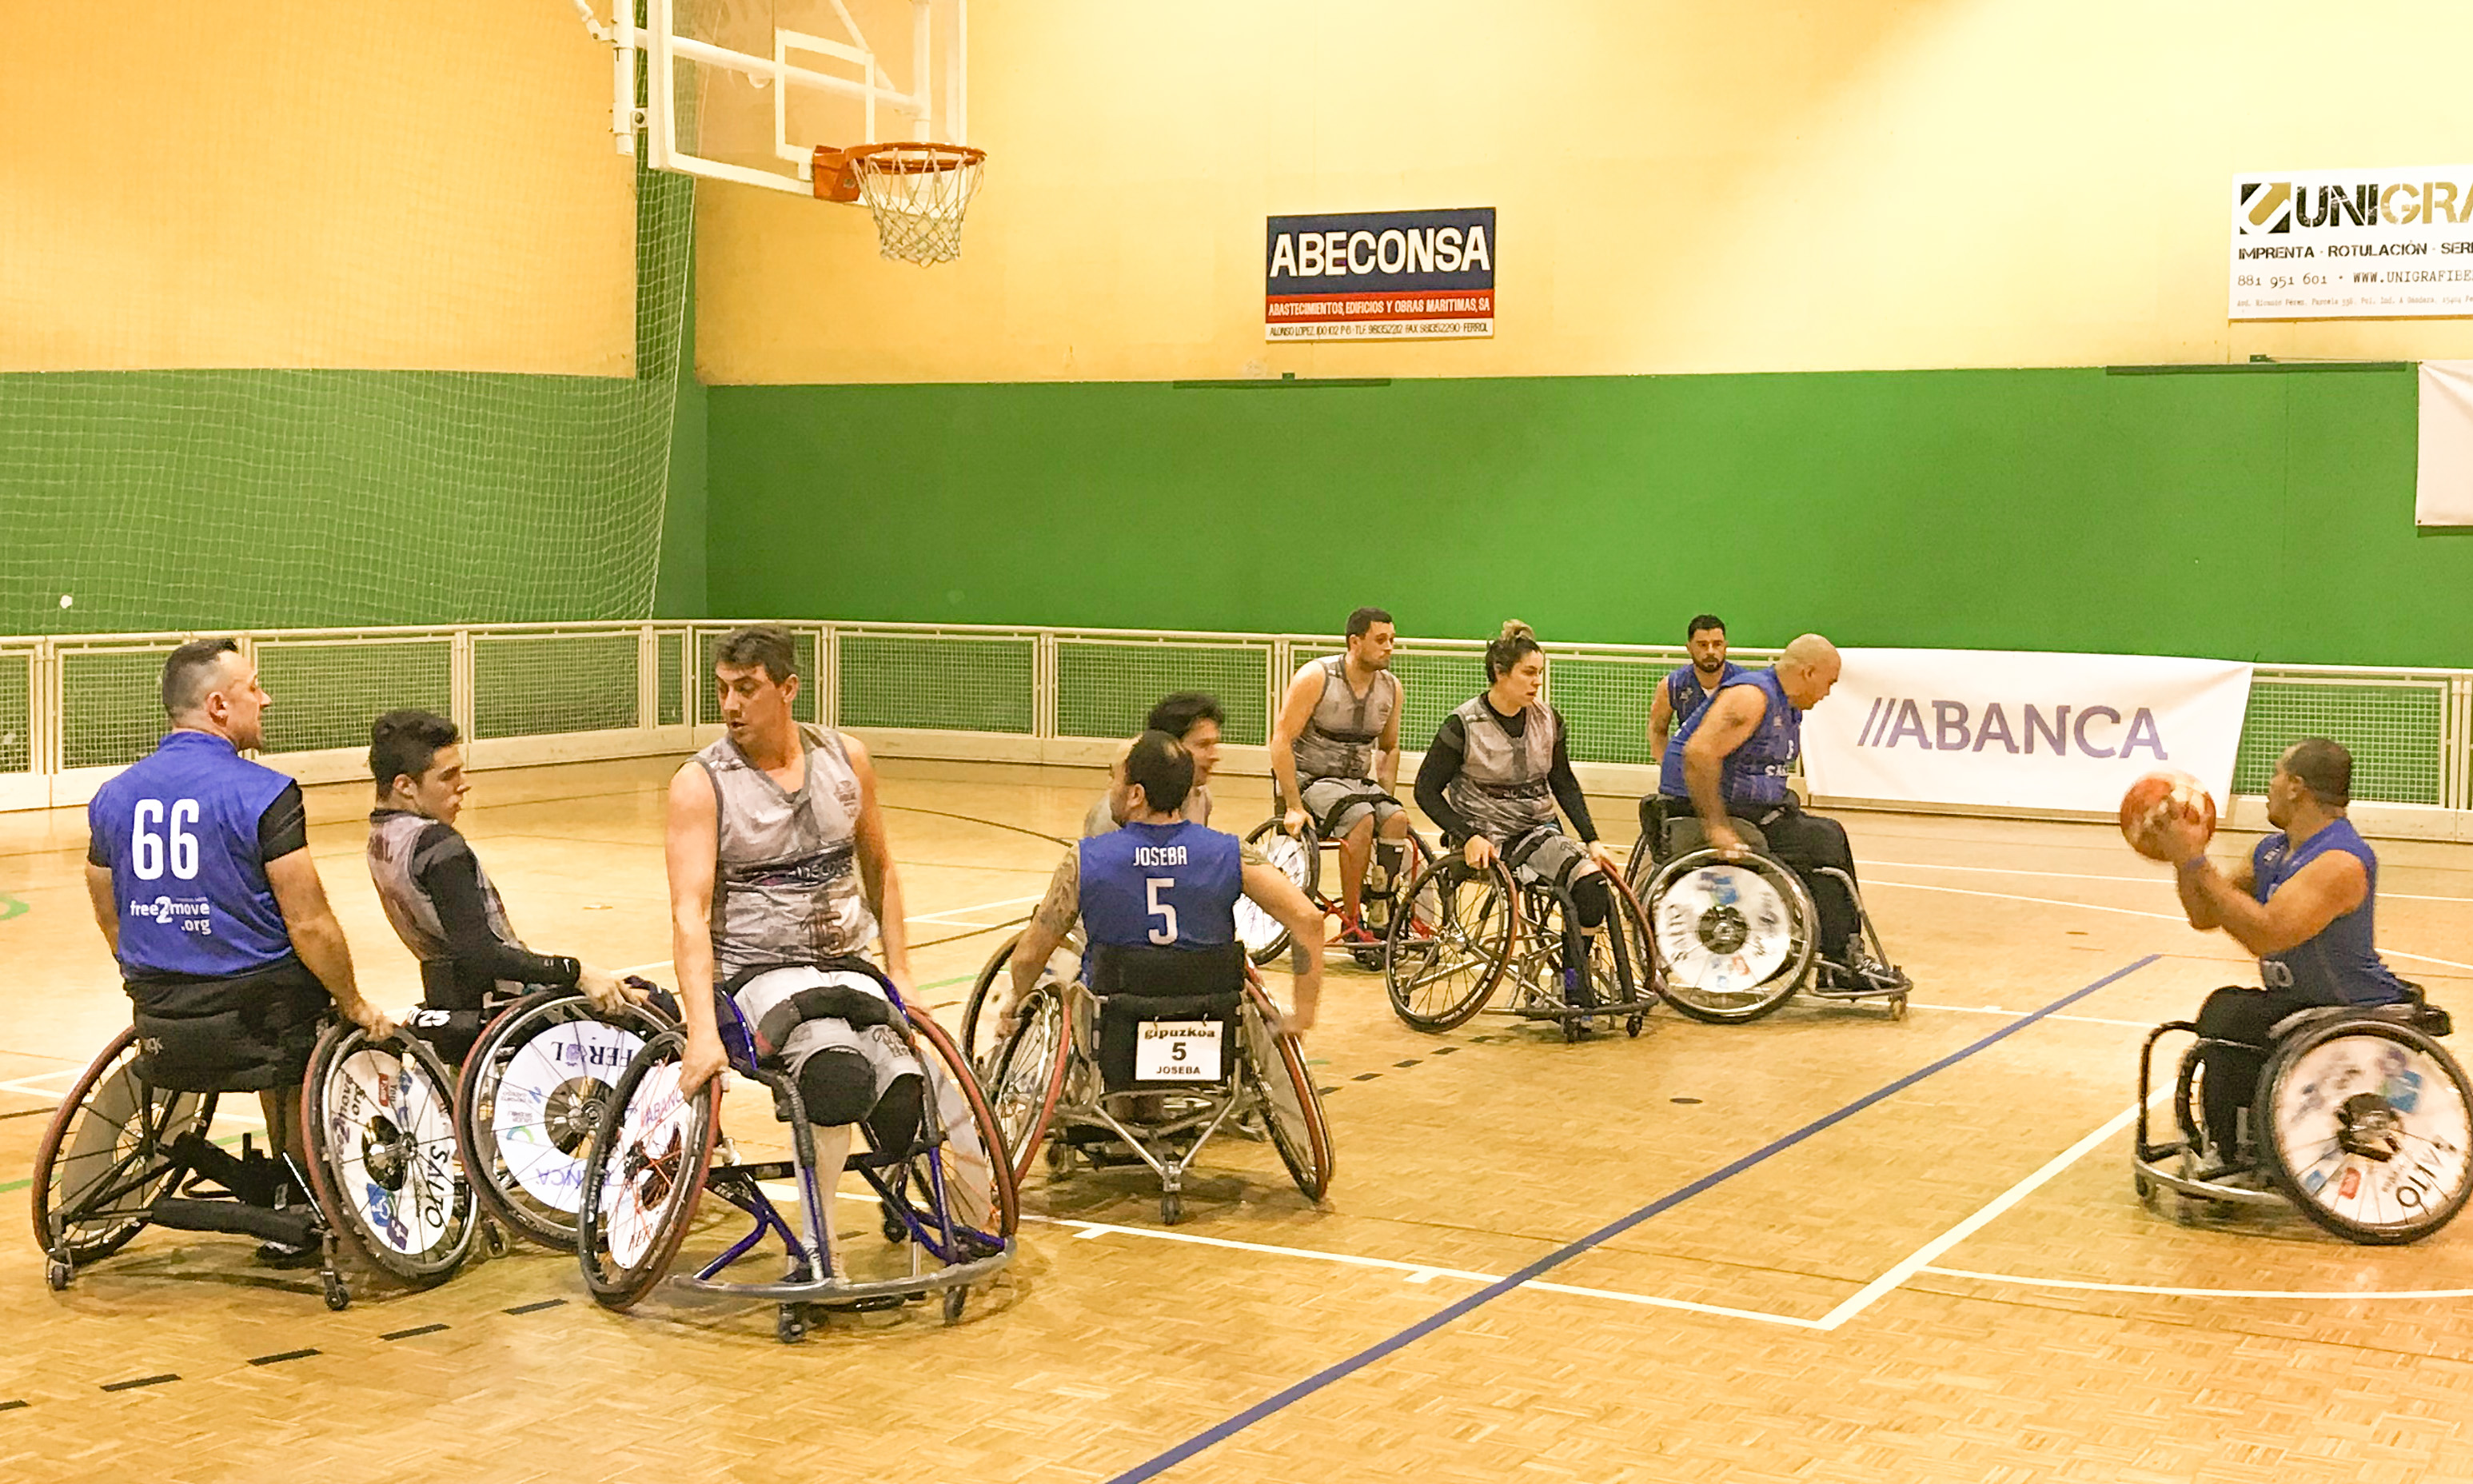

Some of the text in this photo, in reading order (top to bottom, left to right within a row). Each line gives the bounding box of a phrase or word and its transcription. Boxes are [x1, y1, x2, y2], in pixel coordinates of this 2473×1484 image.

[1270, 225, 1490, 277] ABECONSA
[2239, 245, 2315, 260] IMPRENTA
[2327, 240, 2427, 257] ROTULACIÓN
[2238, 269, 2473, 289] 881 951 601 WWW.UNIGRAFIBE
[1346, 299, 1384, 314] EDIFICIOS
[1386, 300, 1393, 313] Y
[1394, 299, 1424, 313] OBRAS
[1478, 297, 1490, 312] SA
[132, 798, 199, 880] 66
[1133, 845, 1188, 866] JOSEBA
[130, 896, 209, 924] free2move
[1146, 877, 1178, 946] 5
[181, 919, 211, 935] .org
[1144, 1027, 1215, 1039] gipuzkoa
[1171, 1042, 1187, 1061] 5
[1156, 1066, 1201, 1075] JOSEBA
[645, 1086, 685, 1125] ABANC
[425, 1145, 449, 1228] SALTO
